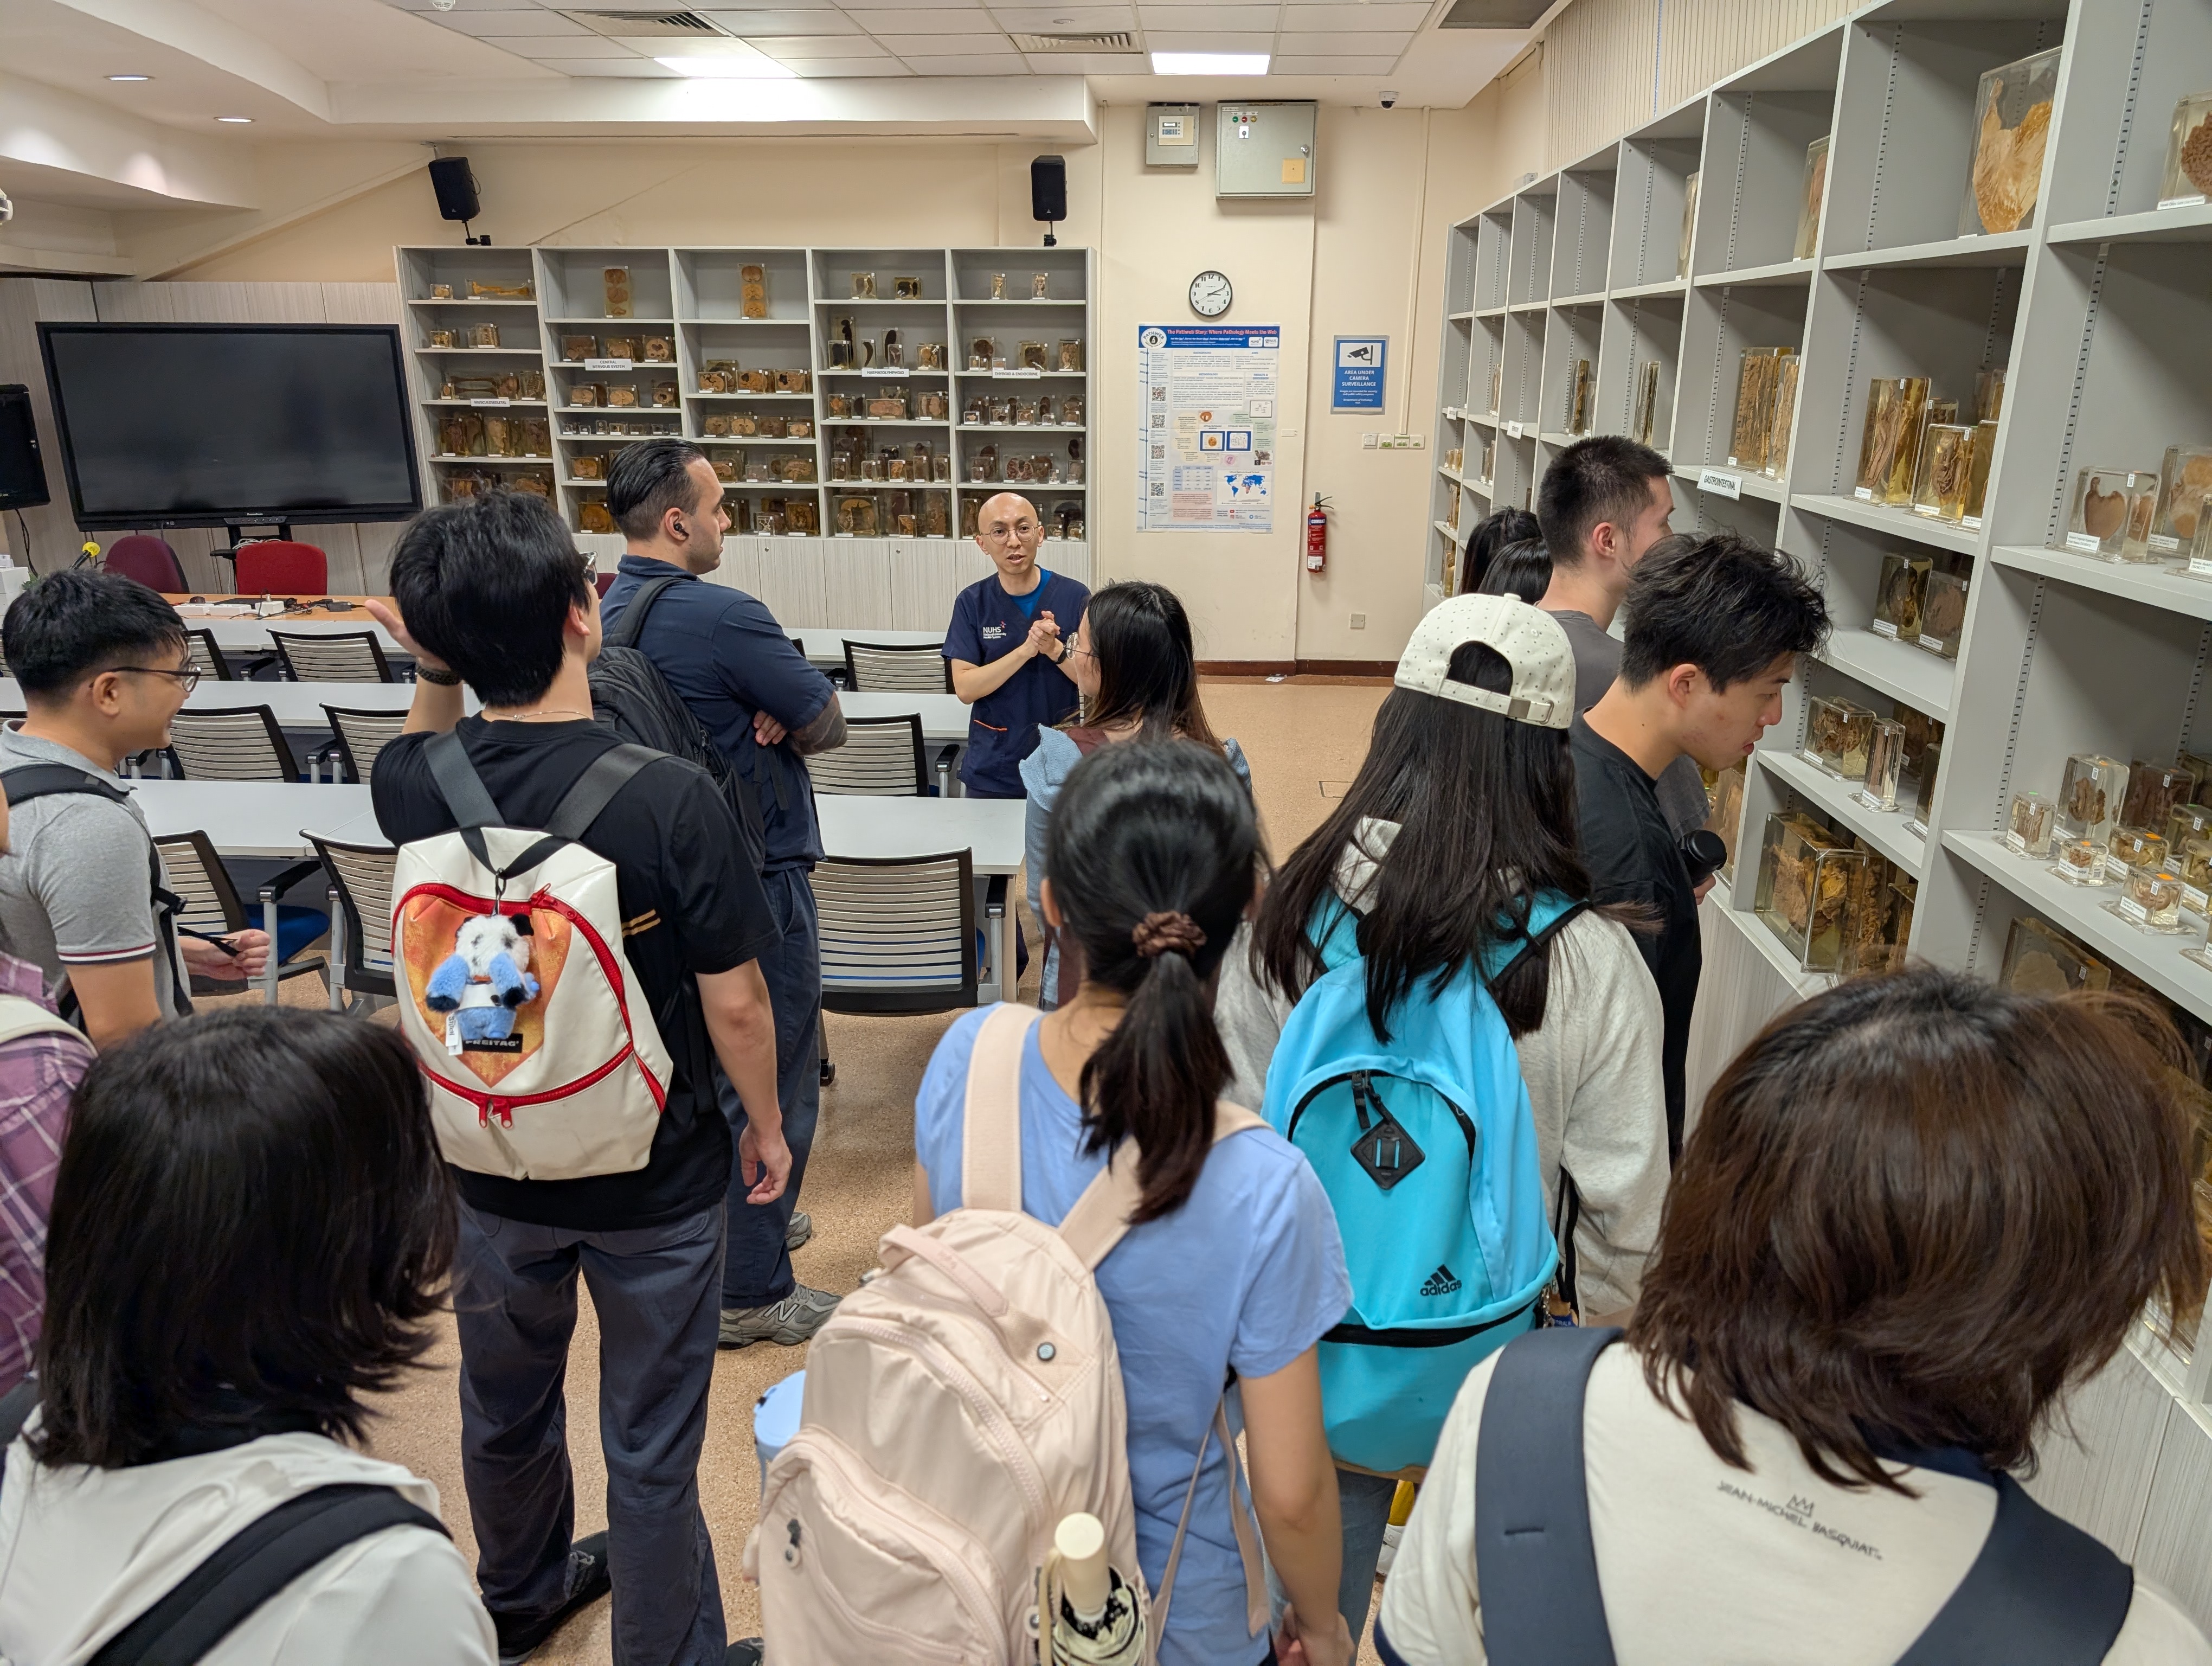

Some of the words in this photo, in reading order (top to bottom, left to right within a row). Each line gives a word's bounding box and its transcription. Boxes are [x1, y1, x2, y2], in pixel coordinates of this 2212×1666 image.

[1143, 331, 1165, 339] PATHWEB
[1703, 475, 1736, 490] GASTROINTESTINAL
[1420, 1280, 1462, 1296] adidas
[1716, 1479, 1807, 1528] JEAN-MICHEL
